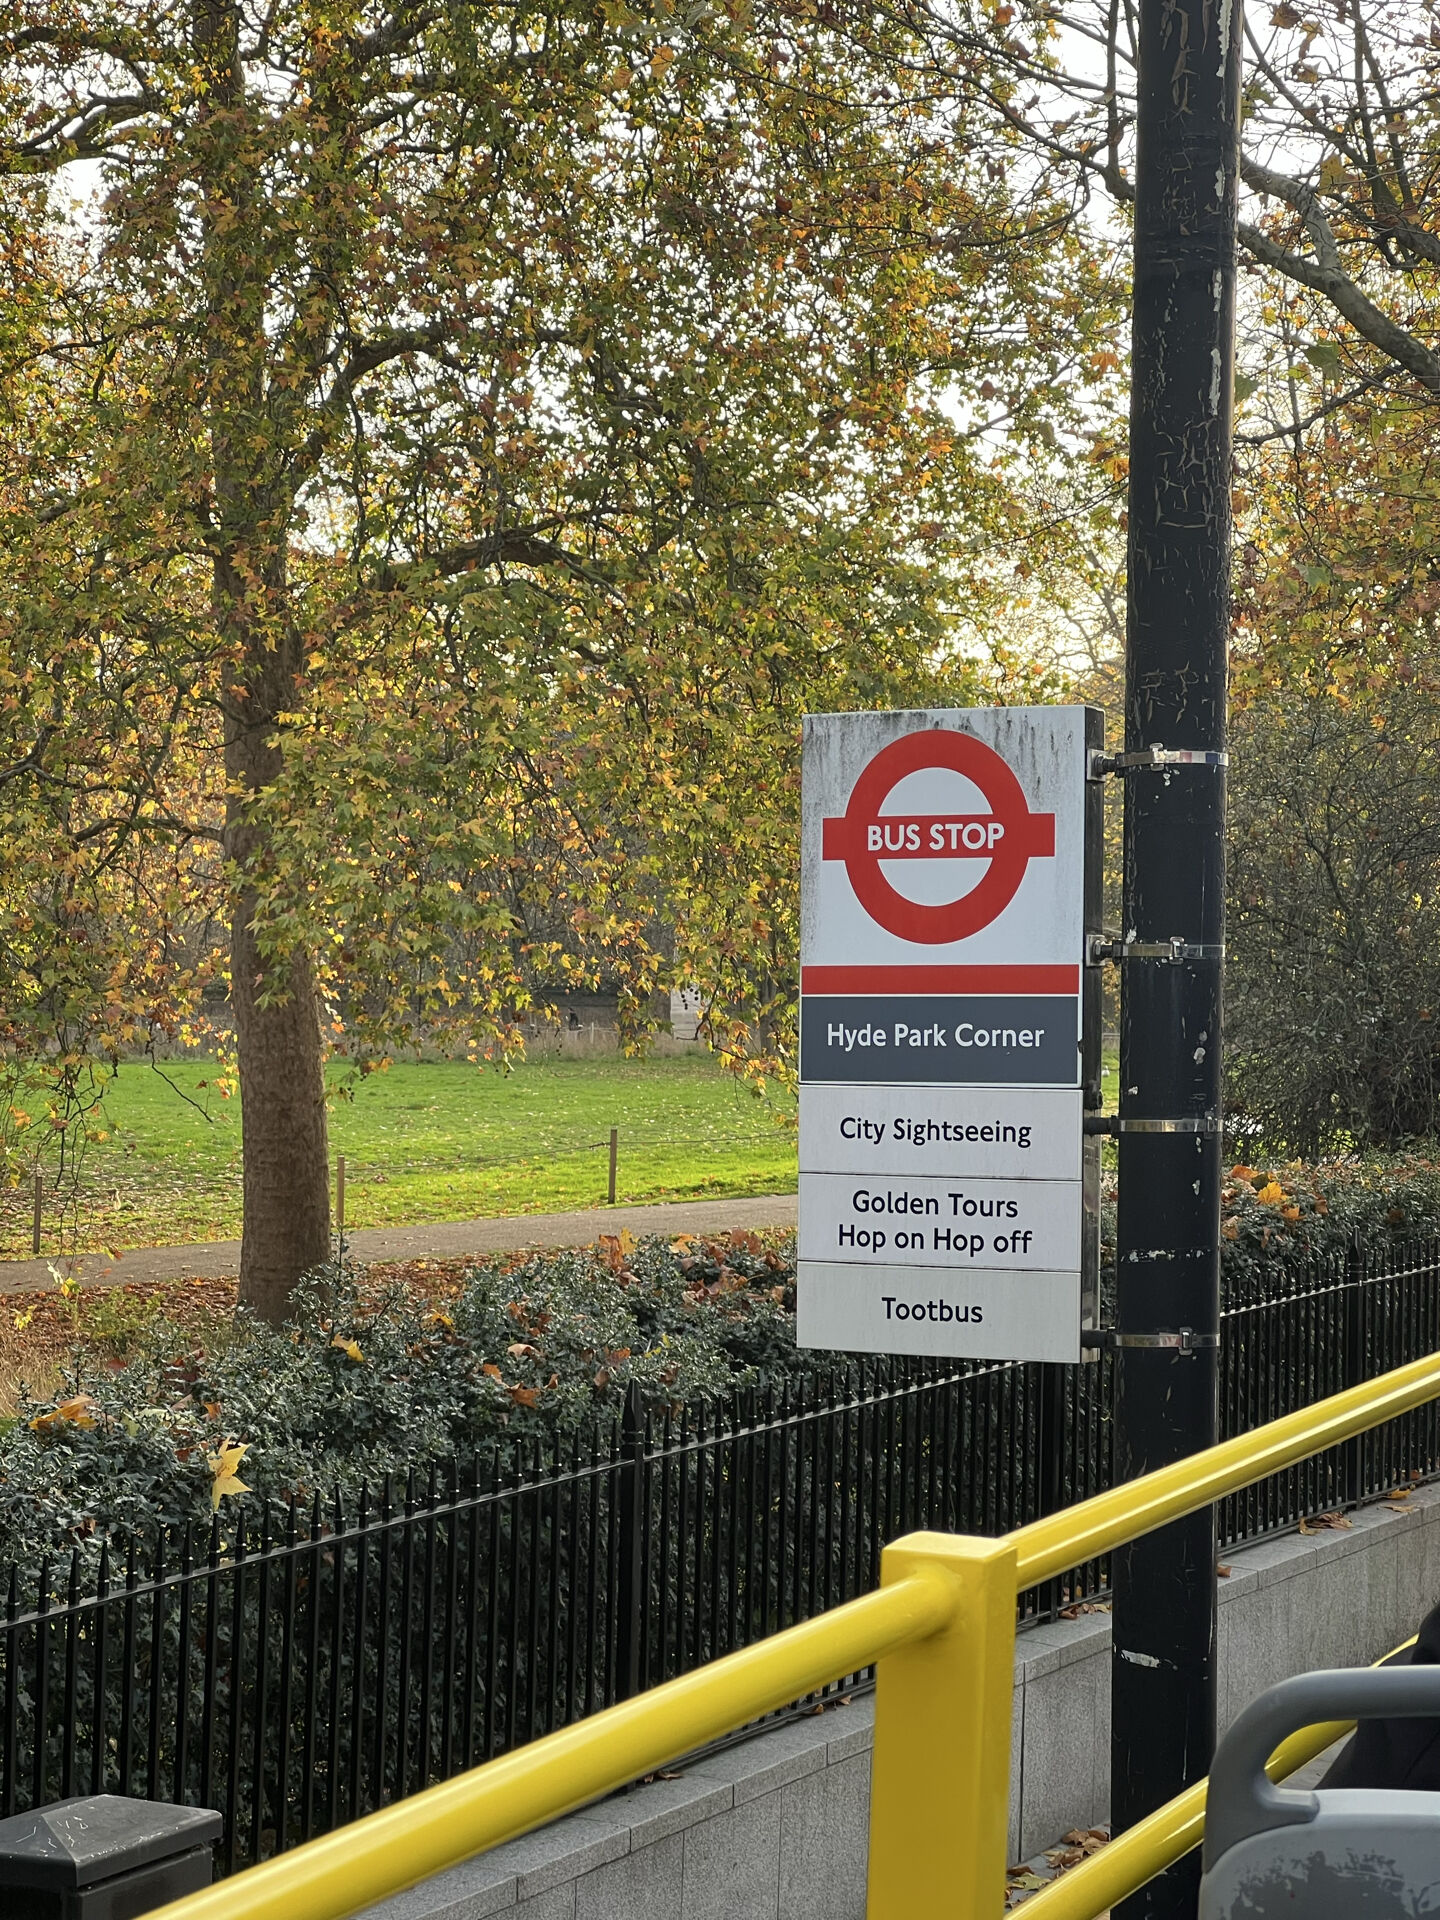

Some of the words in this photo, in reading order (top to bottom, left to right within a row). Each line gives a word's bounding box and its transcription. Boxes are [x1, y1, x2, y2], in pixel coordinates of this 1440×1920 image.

[867, 823, 921, 851] BUS
[928, 822, 1005, 851] STOP
[827, 1023, 887, 1052] Hyde
[894, 1023, 947, 1047] Park
[954, 1023, 1045, 1048] Corner
[839, 1116, 886, 1145] City
[892, 1117, 1032, 1149] Sightseeing
[852, 1189, 939, 1215] Golden
[947, 1192, 1019, 1218] Tours
[838, 1223, 887, 1254] Hop
[894, 1231, 925, 1250] on
[933, 1227, 985, 1258] Hop
[993, 1229, 1033, 1254] off
[881, 1296, 983, 1324] Tootbus
